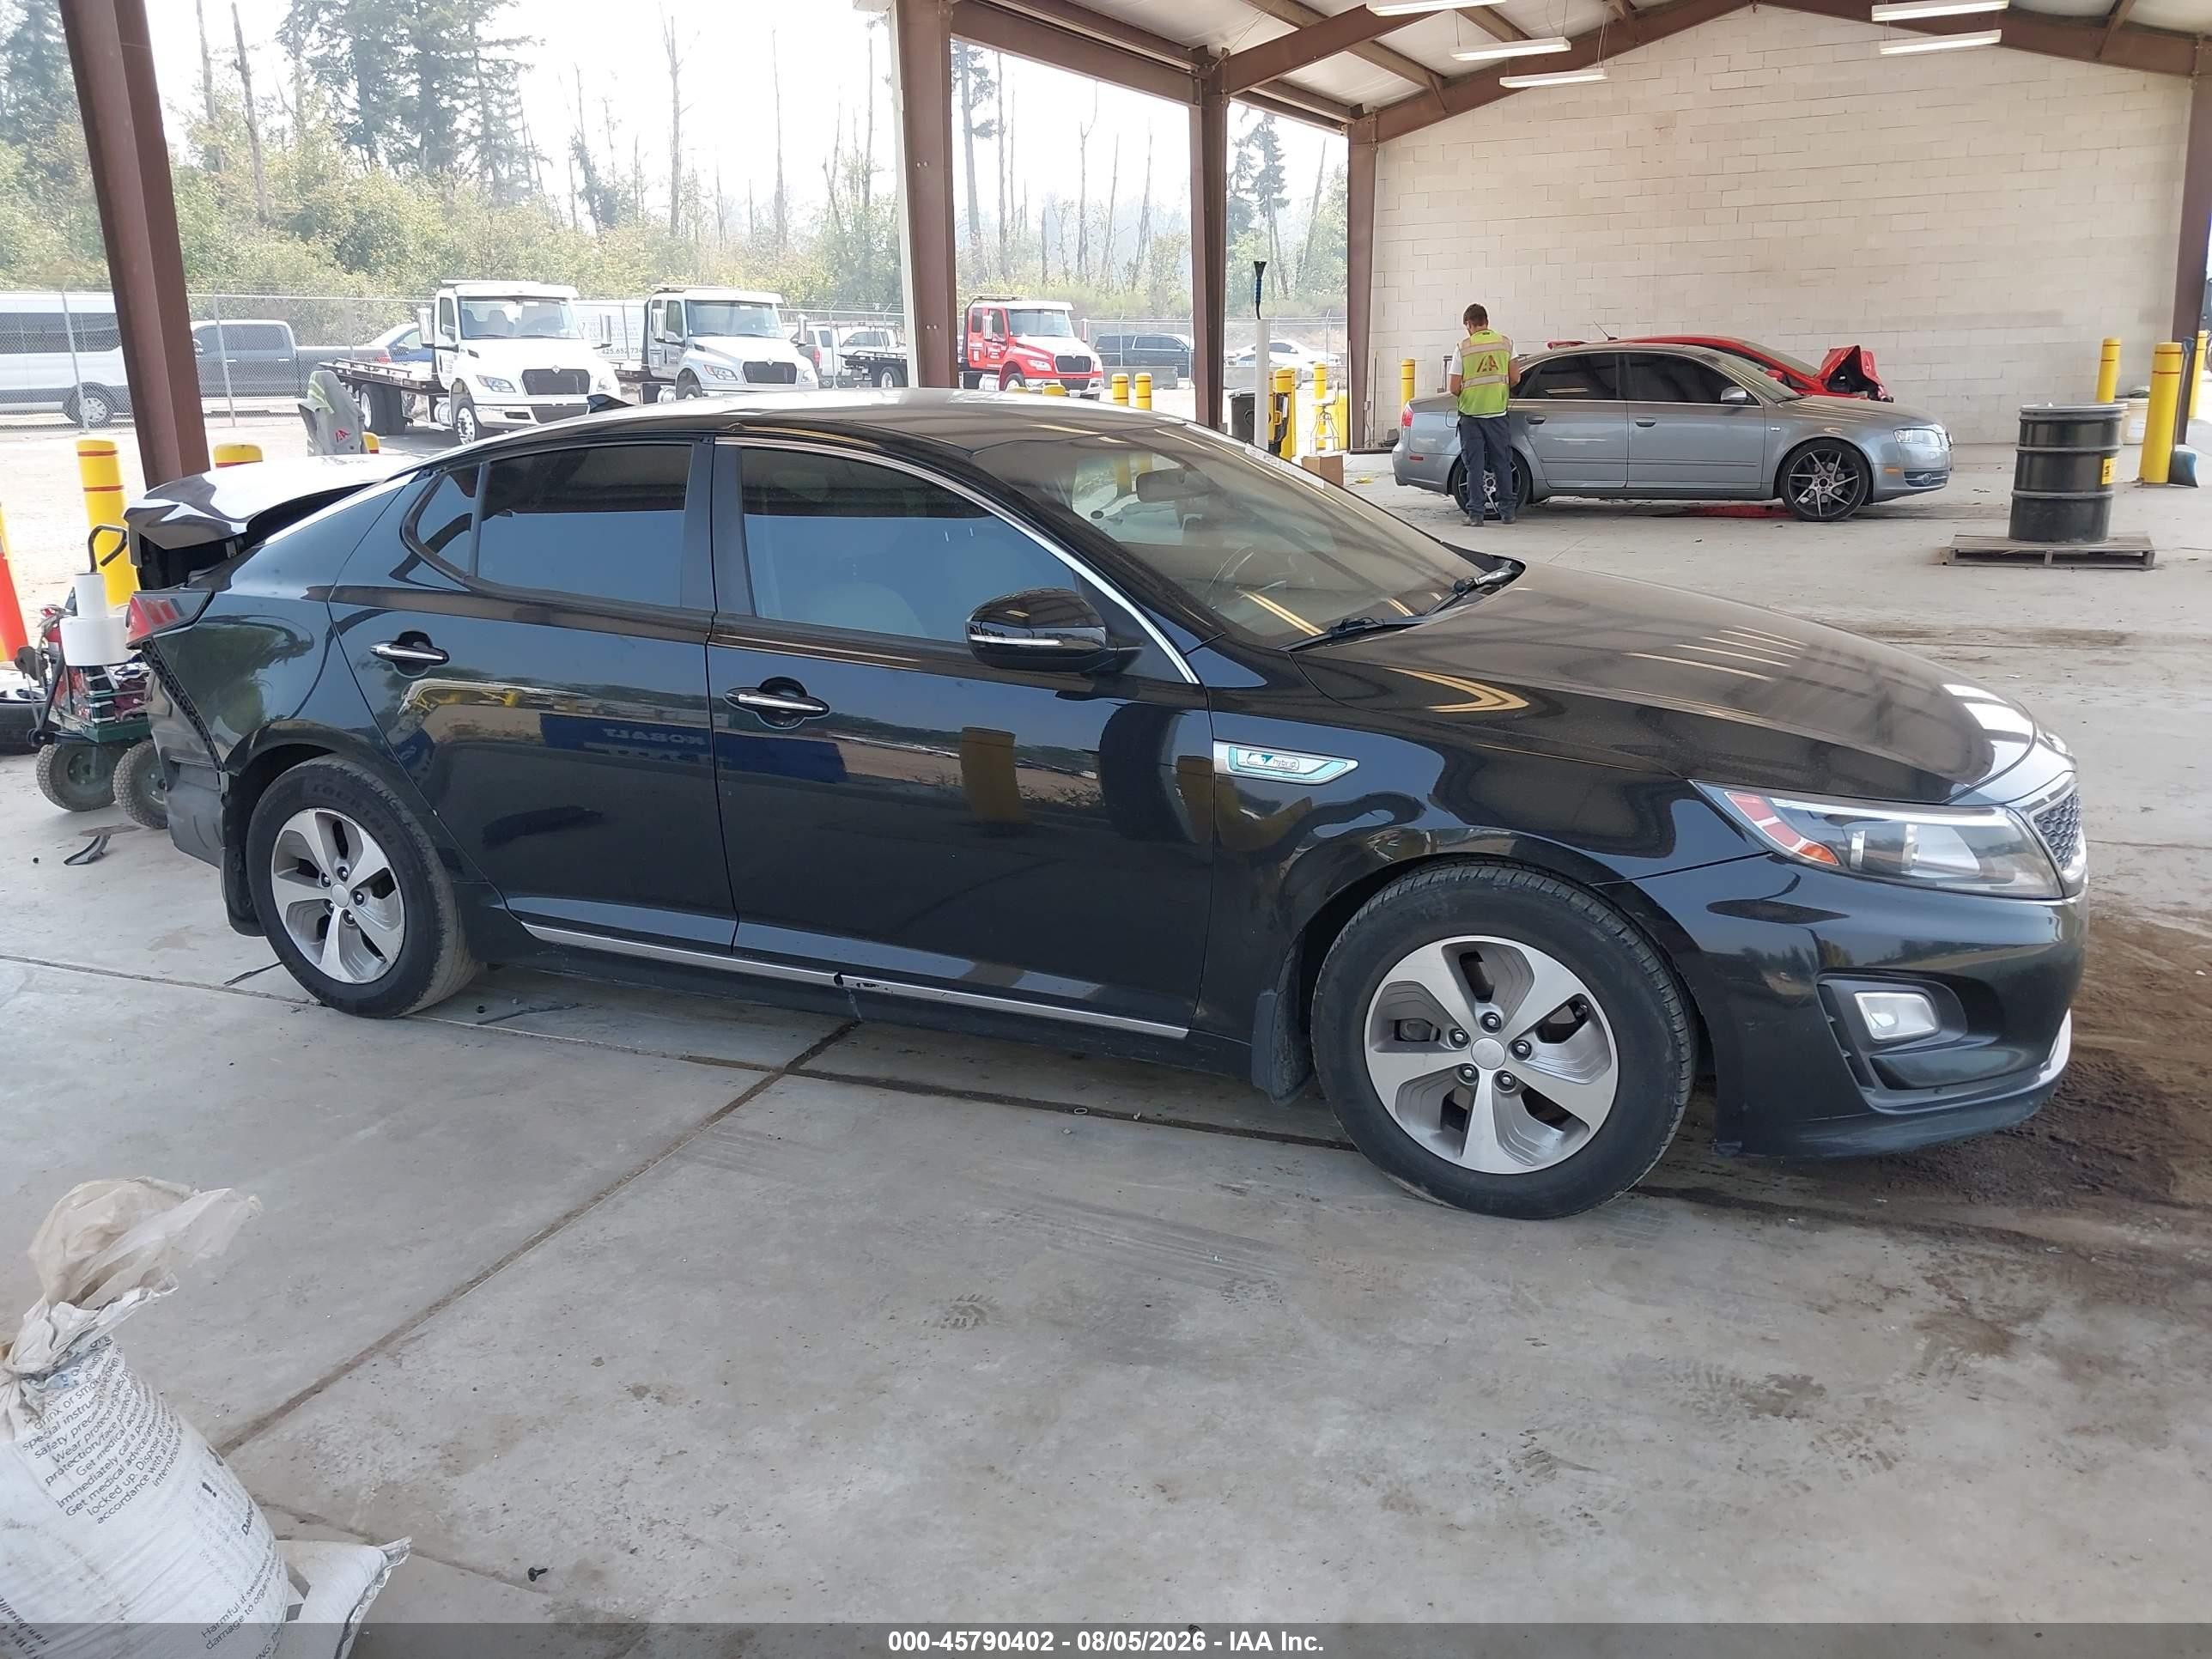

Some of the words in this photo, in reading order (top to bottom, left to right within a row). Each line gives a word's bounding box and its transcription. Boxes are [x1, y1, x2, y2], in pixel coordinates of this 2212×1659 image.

[62, 1396, 74, 1408] or
[22, 1420, 62, 1451] special
[34, 1433, 69, 1460] safety
[52, 1439, 82, 1463] Wear
[76, 1460, 96, 1475] Get
[96, 1425, 127, 1460] medical
[55, 1456, 118, 1508] Immediately
[118, 1439, 131, 1456] call
[65, 1499, 89, 1516] Get
[89, 1463, 125, 1501] medical
[86, 1484, 124, 1516] locked
[136, 1437, 160, 1472] Dispose
[96, 1474, 151, 1525] accordance
[148, 1455, 163, 1474] with
[201, 1602, 240, 1638] Harmful
[240, 1594, 247, 1604] if
[206, 1614, 246, 1649] damage
[244, 1604, 254, 1614] to
